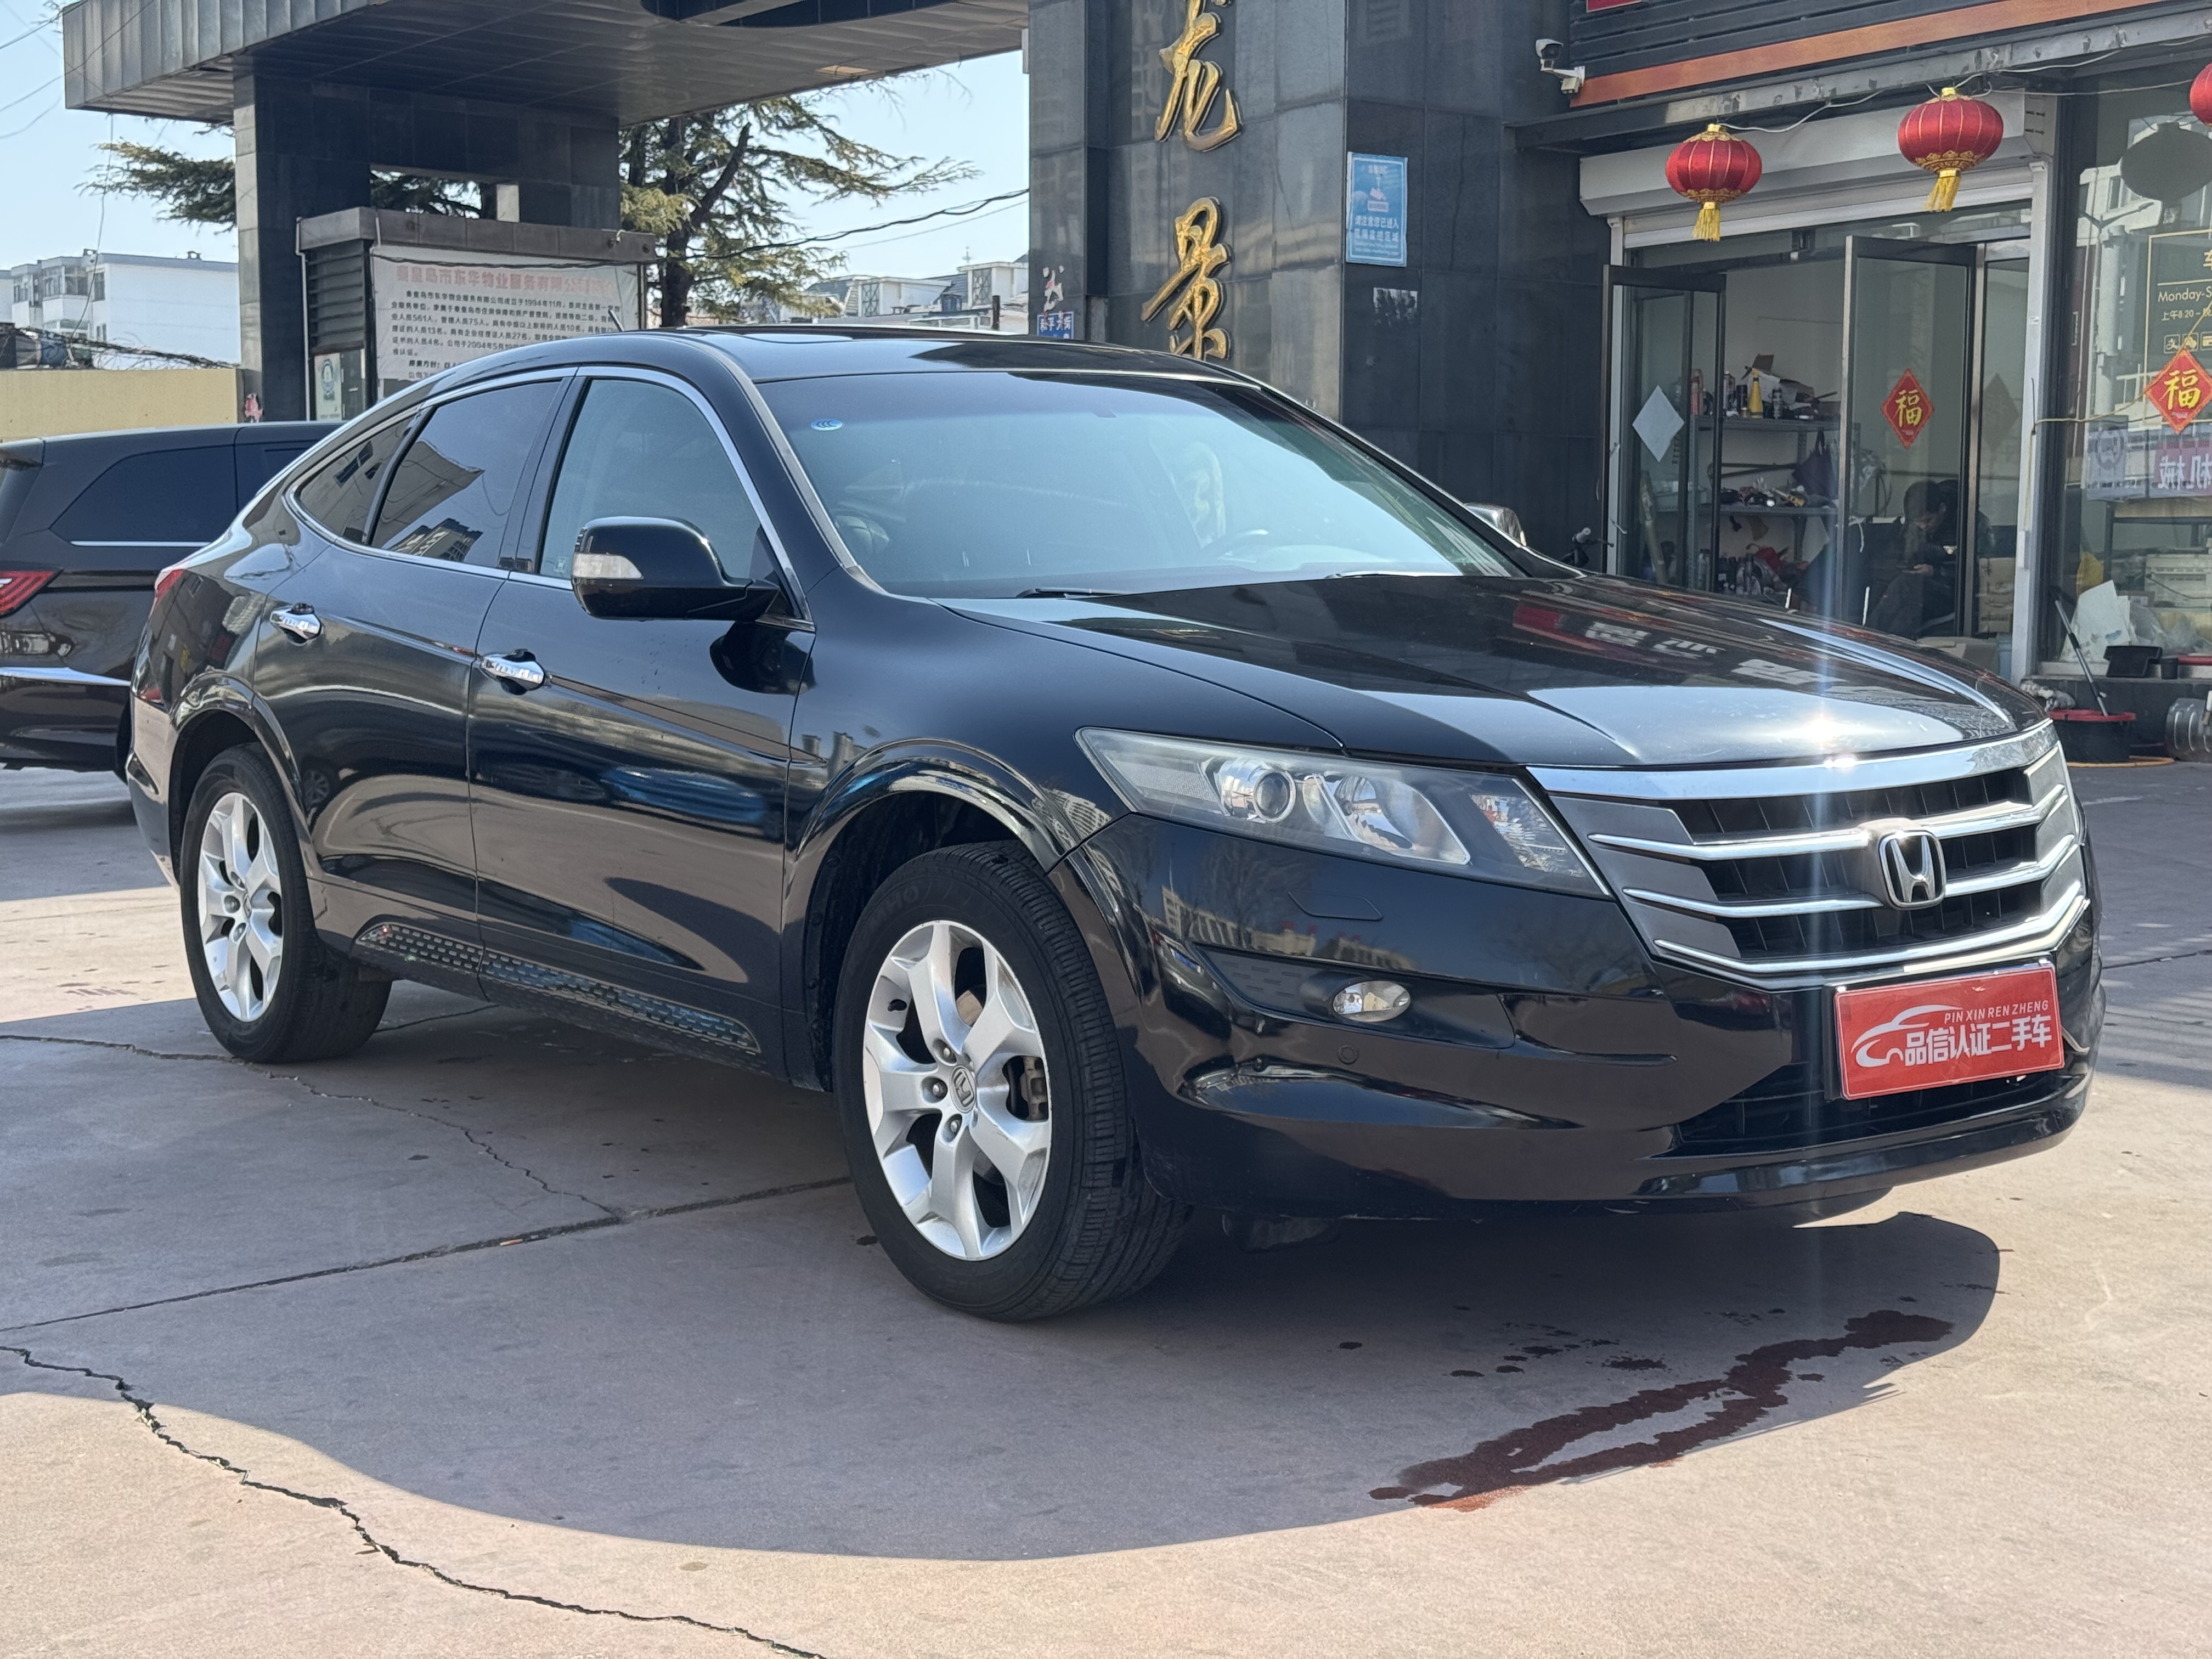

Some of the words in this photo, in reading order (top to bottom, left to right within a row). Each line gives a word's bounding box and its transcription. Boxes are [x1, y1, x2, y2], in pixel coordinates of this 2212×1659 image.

[1893, 389, 1923, 428] 福
[2158, 369, 2201, 410] 福
[1944, 1011, 1963, 1024] PIN
[1966, 1008, 1985, 1022] XIN
[1988, 1005, 2010, 1018] REN
[2012, 1000, 2049, 1015] ZHENG
[1905, 1014, 2052, 1066] 品信认证二手车
